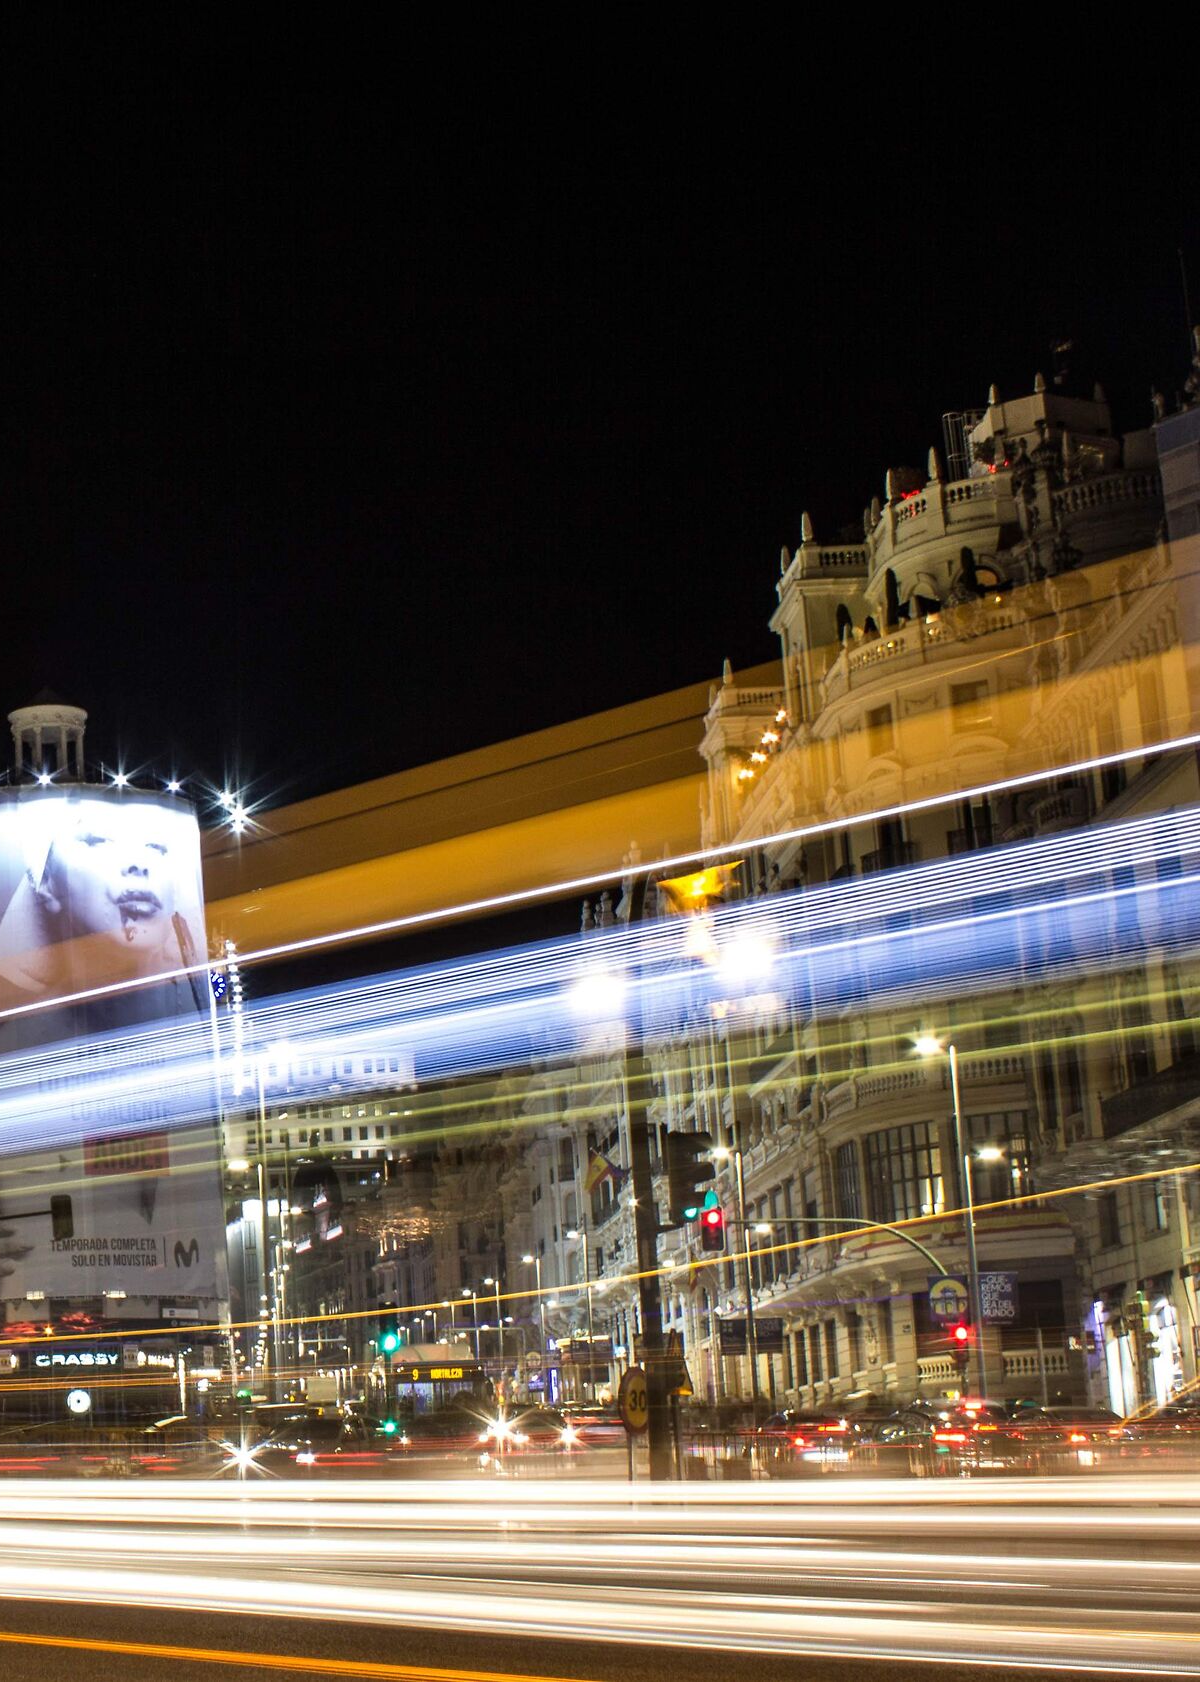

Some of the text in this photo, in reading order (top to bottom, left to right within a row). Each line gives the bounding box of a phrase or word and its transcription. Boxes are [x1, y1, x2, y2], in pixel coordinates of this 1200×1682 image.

[51, 1238, 157, 1252] TEMPORADA COMPLETA
[72, 1254, 157, 1267] SOLO EN MOVISTAR
[412, 1369, 419, 1381] 9
[629, 1389, 647, 1411] 30
